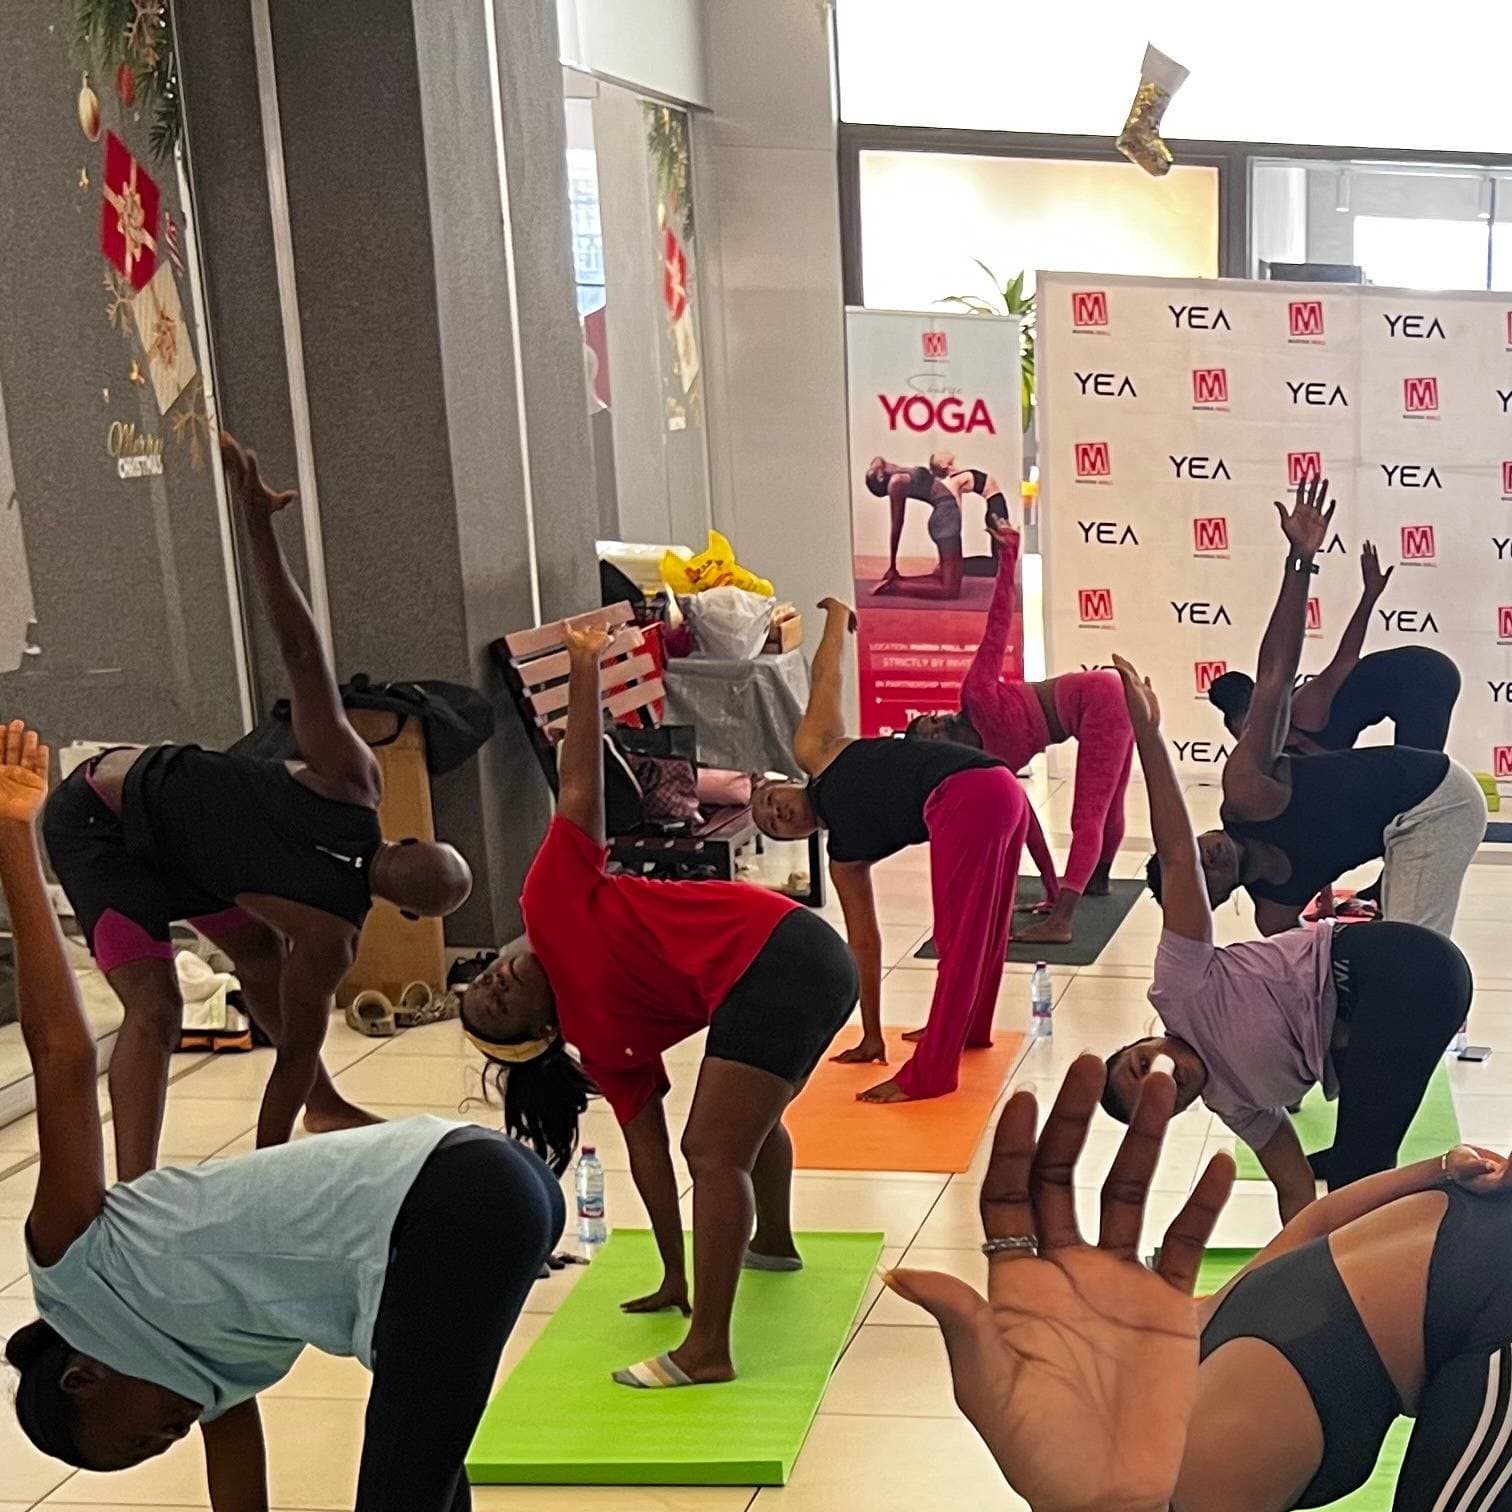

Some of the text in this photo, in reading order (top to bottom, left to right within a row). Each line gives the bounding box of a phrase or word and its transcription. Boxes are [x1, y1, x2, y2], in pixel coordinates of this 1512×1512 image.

[1169, 305, 1231, 330] YEA
[1384, 314, 1446, 339] YEA
[1074, 372, 1137, 397] YEA
[1286, 381, 1348, 406] YEA
[877, 394, 997, 435] YOGA
[1169, 455, 1231, 480] YEA
[1380, 464, 1442, 489] YEA
[1077, 521, 1139, 546] YEA
[1170, 601, 1231, 626] YEA
[1379, 610, 1439, 633] YEA
[882, 657, 929, 668] STRICTLY
